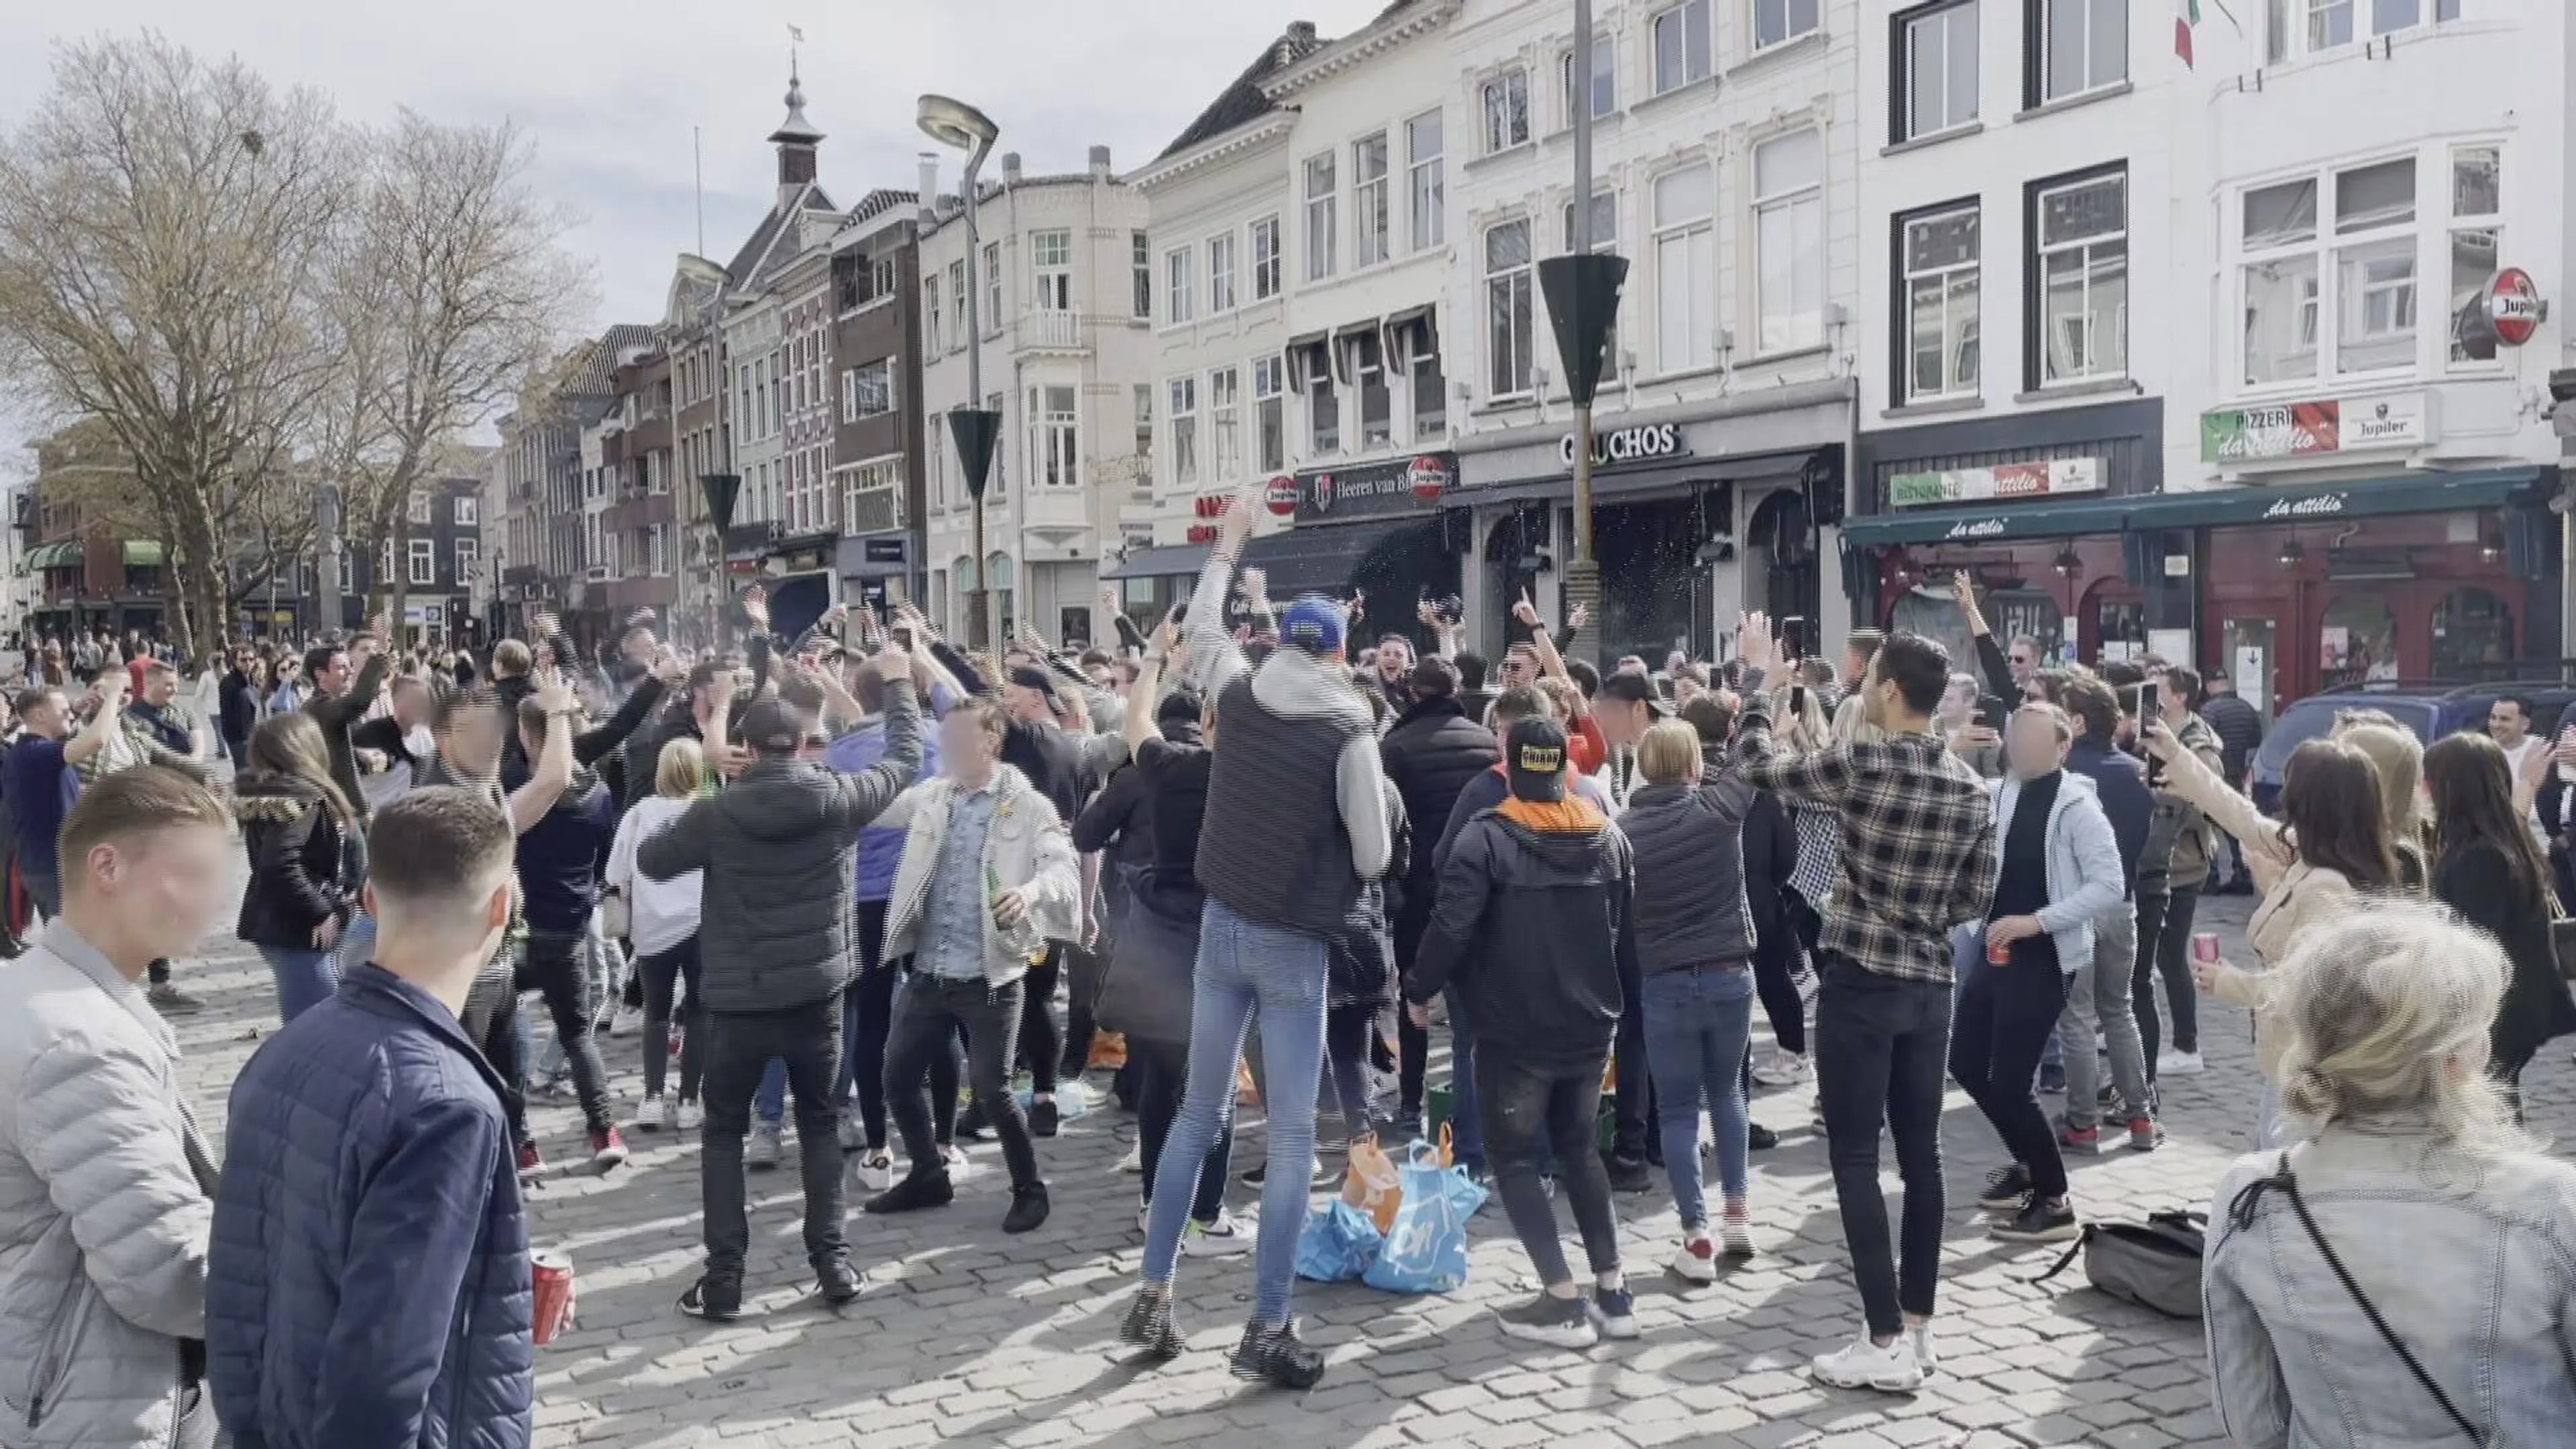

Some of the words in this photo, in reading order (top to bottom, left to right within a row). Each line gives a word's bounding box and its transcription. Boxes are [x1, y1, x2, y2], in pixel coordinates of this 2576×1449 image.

[2236, 405, 2300, 430] PIZZERIA
[2360, 419, 2407, 436] Jupiler
[1559, 423, 1675, 465] GUCHOS
[1337, 480, 1374, 500] Heeren
[1377, 478, 1395, 494] van
